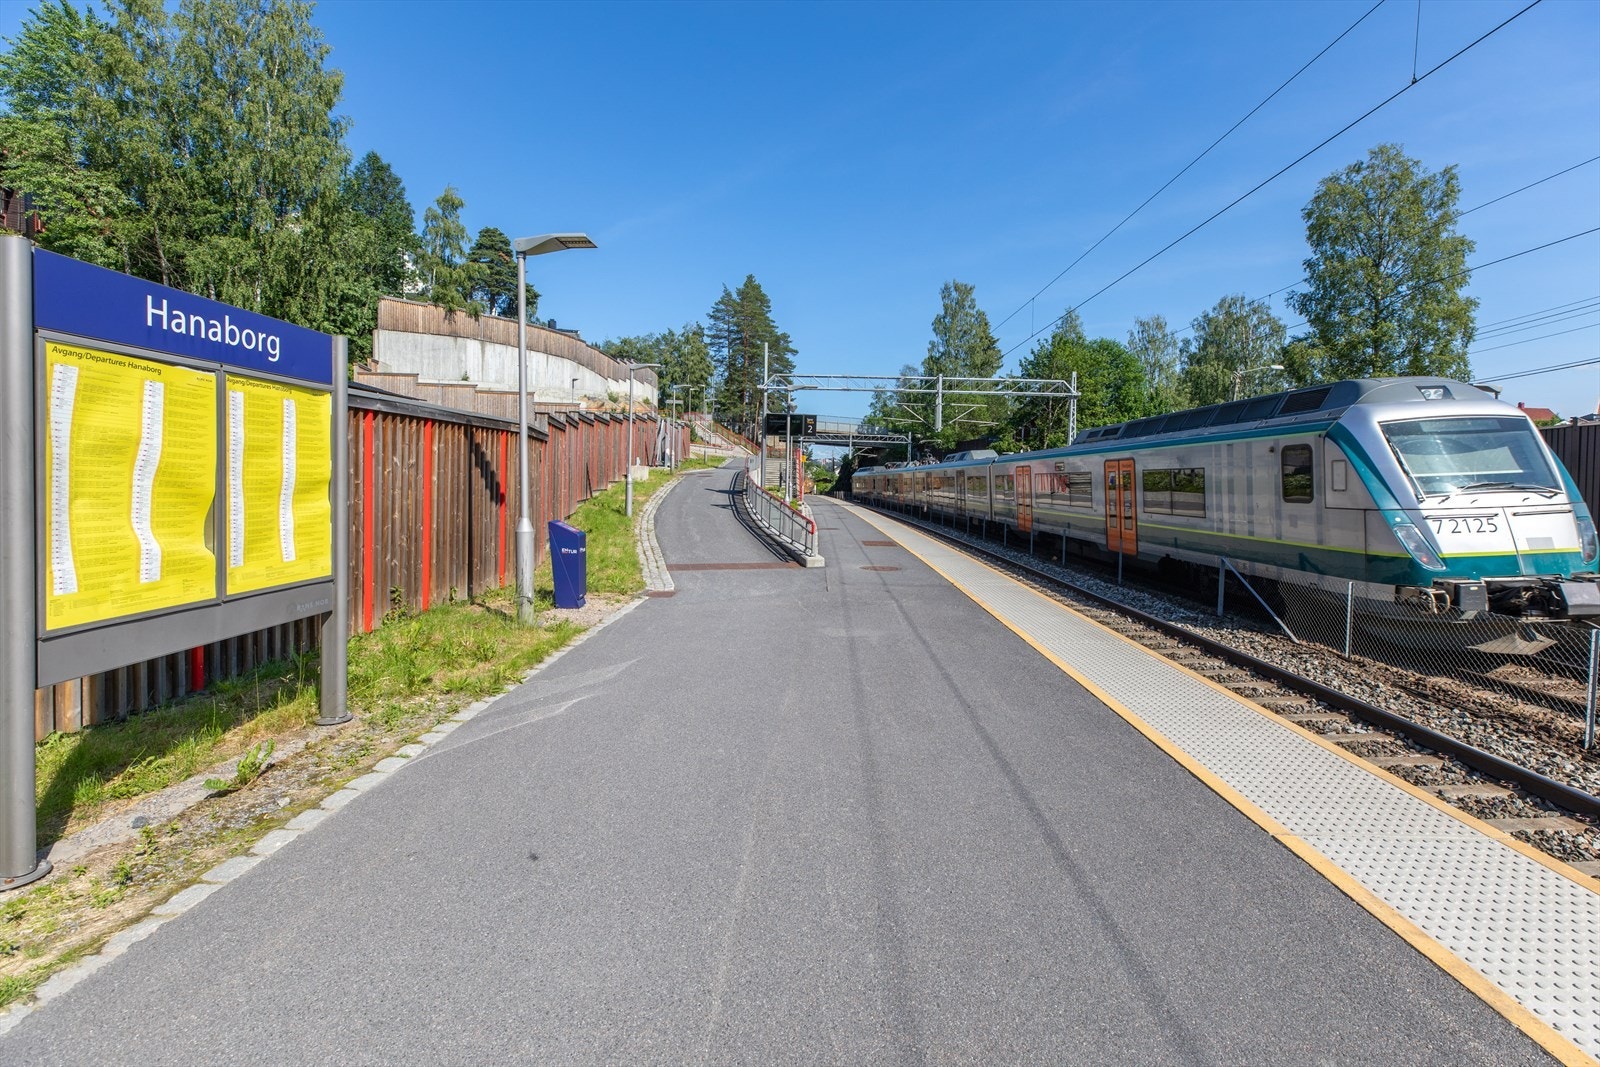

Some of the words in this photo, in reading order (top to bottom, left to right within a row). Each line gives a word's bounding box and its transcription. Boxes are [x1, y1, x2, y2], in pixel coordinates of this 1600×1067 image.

[146, 295, 281, 362] Hanaborg
[51, 345, 127, 368] Avgang/Departures
[127, 361, 163, 376] Hanaborg
[807, 425, 813, 433] 2
[1432, 518, 1498, 534] 72125
